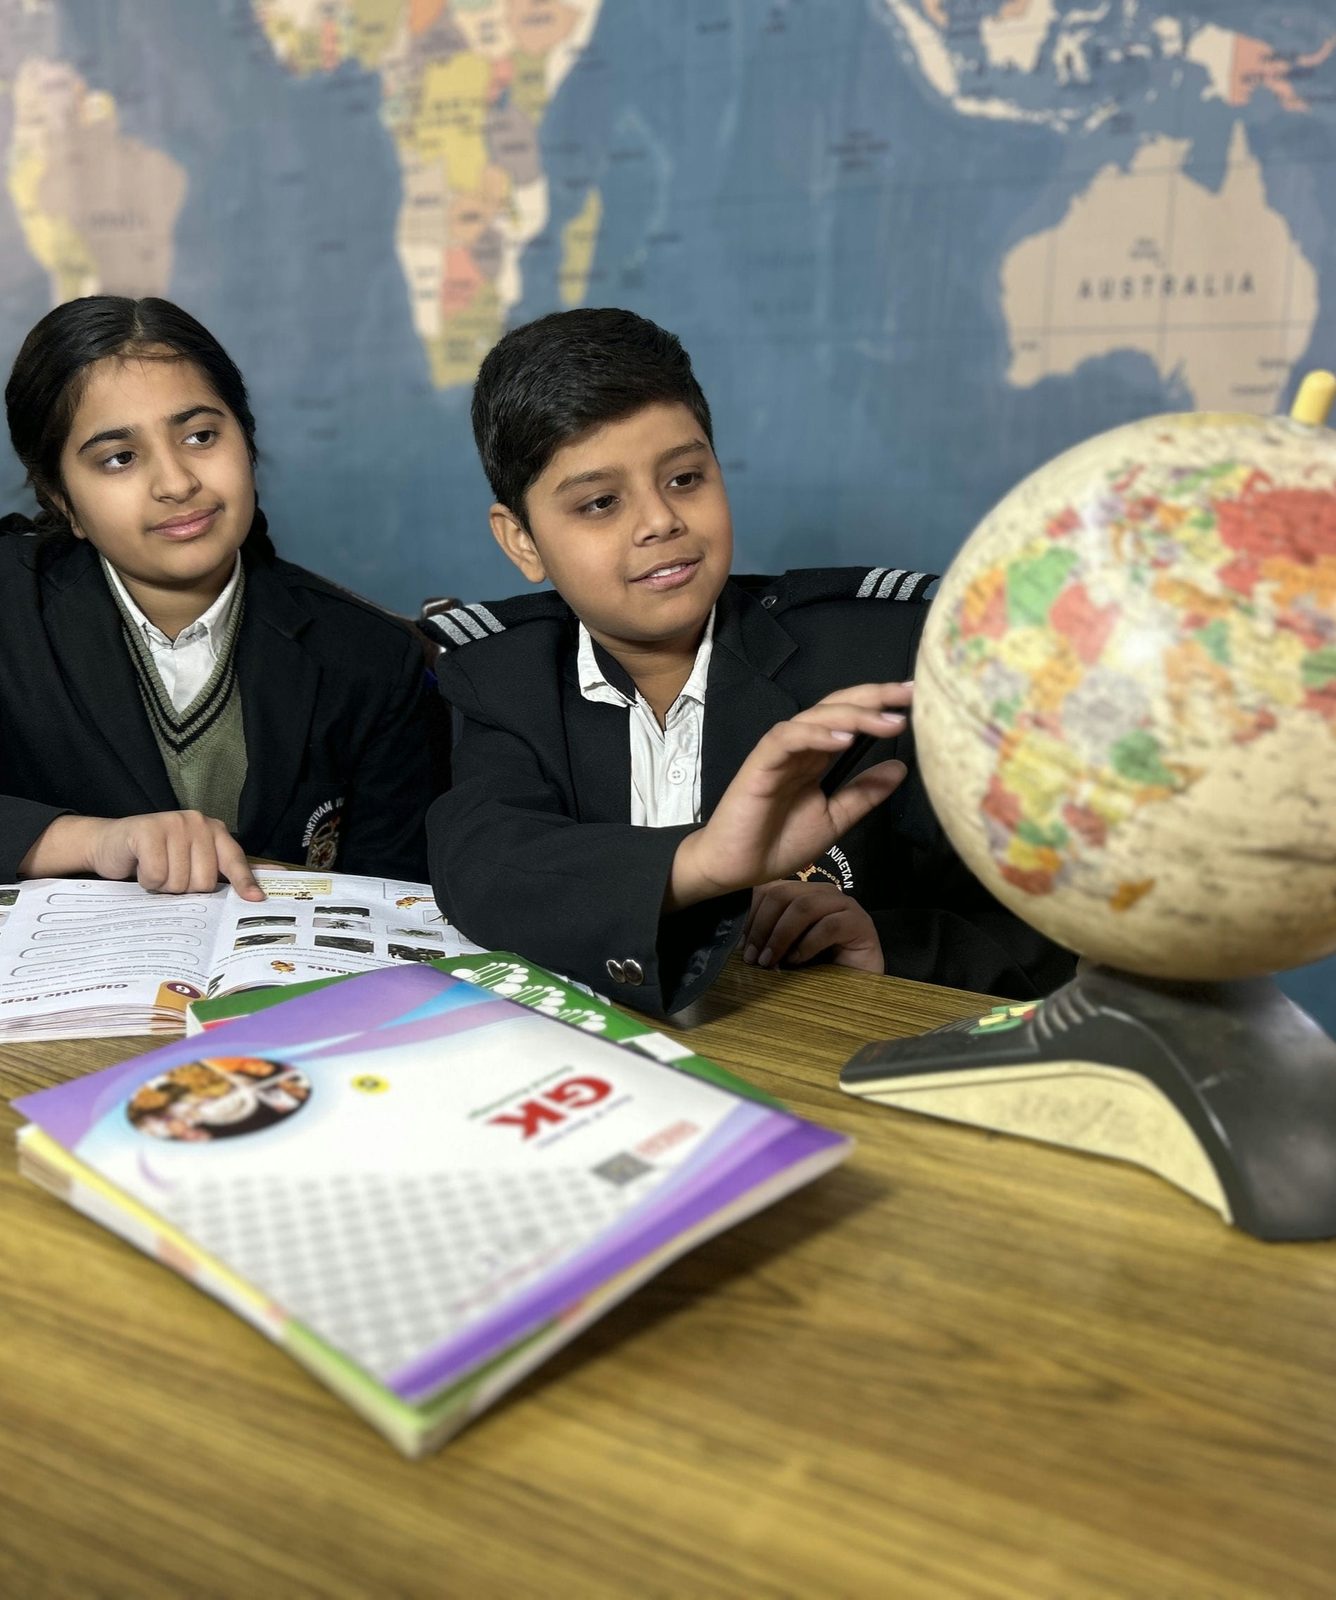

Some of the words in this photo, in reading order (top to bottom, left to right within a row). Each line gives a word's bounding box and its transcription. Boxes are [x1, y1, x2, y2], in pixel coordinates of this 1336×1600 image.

[1078, 271, 1255, 300] AUSTRALIA
[825, 845, 854, 889] NIKETAN
[45, 983, 129, 998] Gigantic
[175, 984, 191, 994] 6
[486, 1076, 614, 1141] GK
